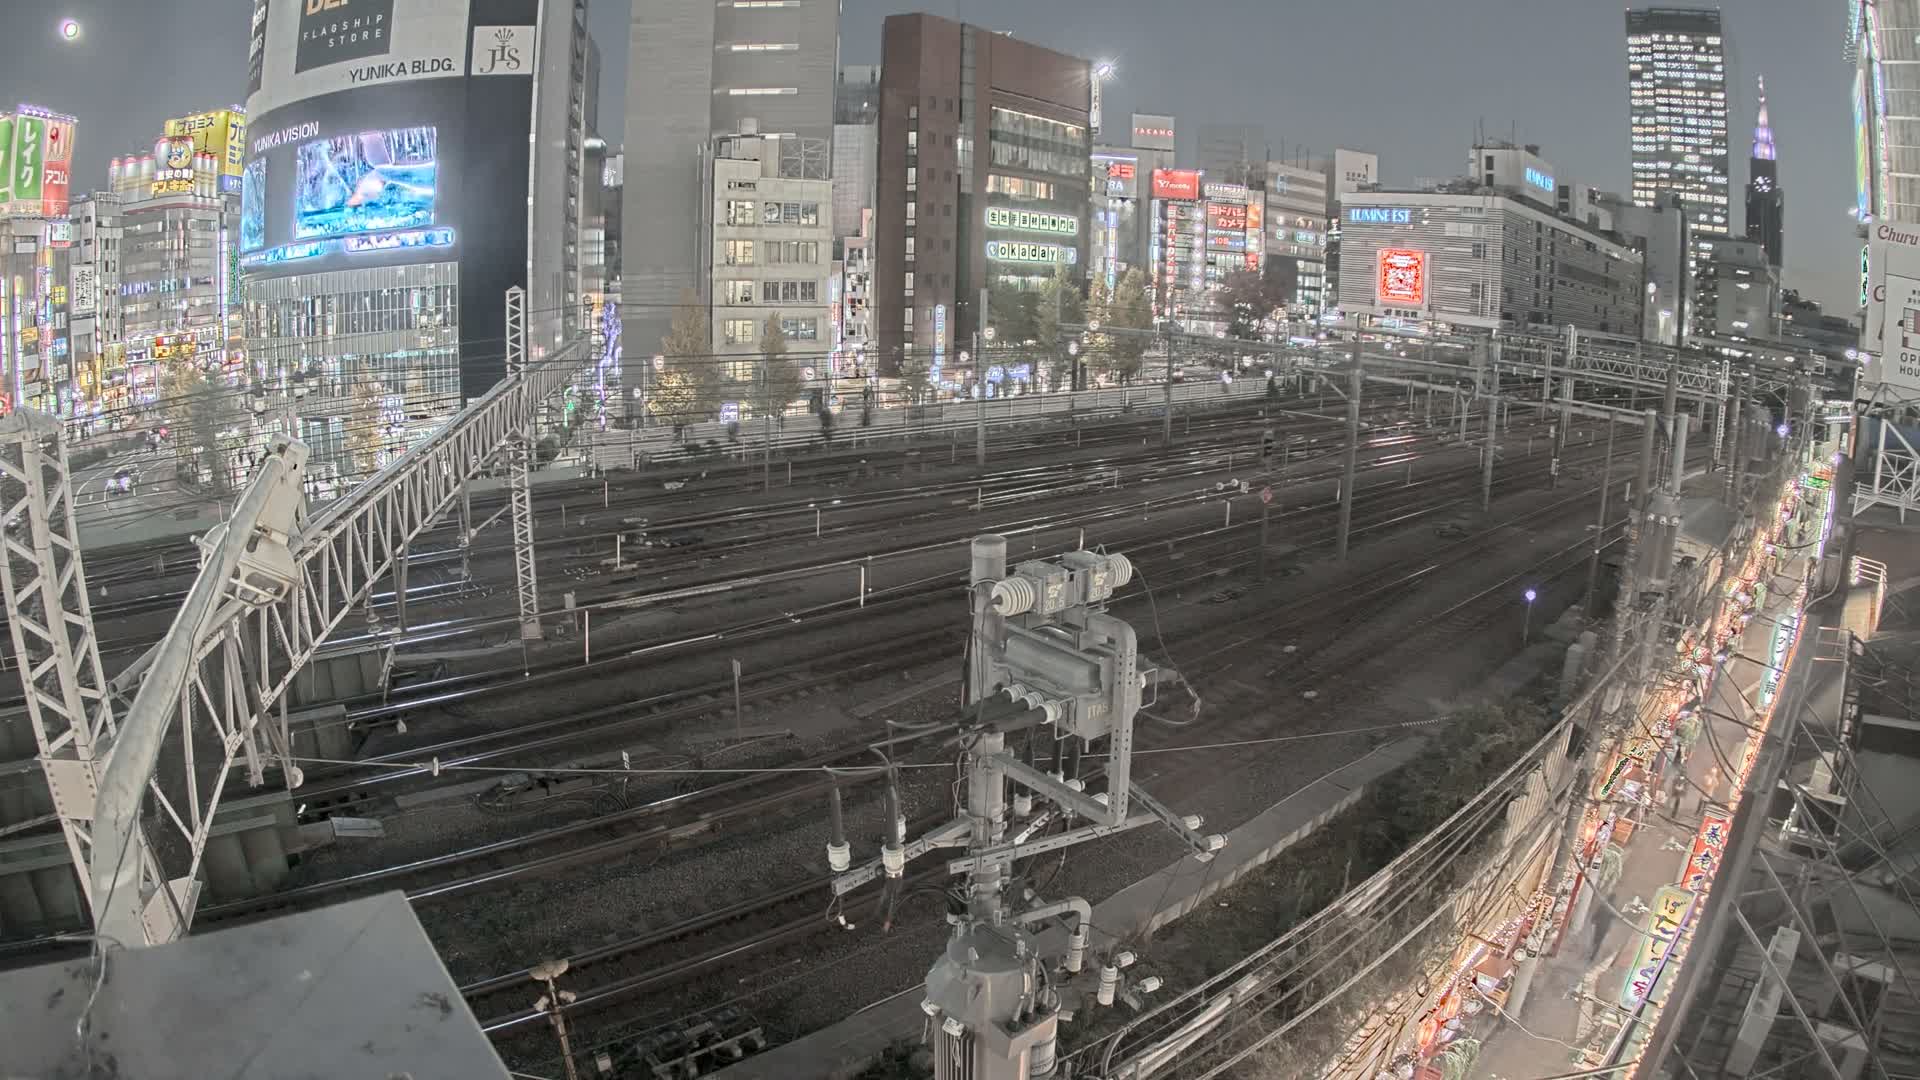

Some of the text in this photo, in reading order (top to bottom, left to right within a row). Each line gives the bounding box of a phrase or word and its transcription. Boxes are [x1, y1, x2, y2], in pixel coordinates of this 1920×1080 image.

[303, 14, 383, 41] FLAGSHIP
[328, 28, 382, 48] STORE
[349, 57, 456, 83] YUNIKA BLDG.
[254, 120, 320, 153] YUNIKA VISION
[22, 120, 37, 188] レイク
[45, 169, 69, 185] アコム
[1350, 208, 1411, 223] LUMINE EST
[1000, 245, 1066, 260] okadaya
